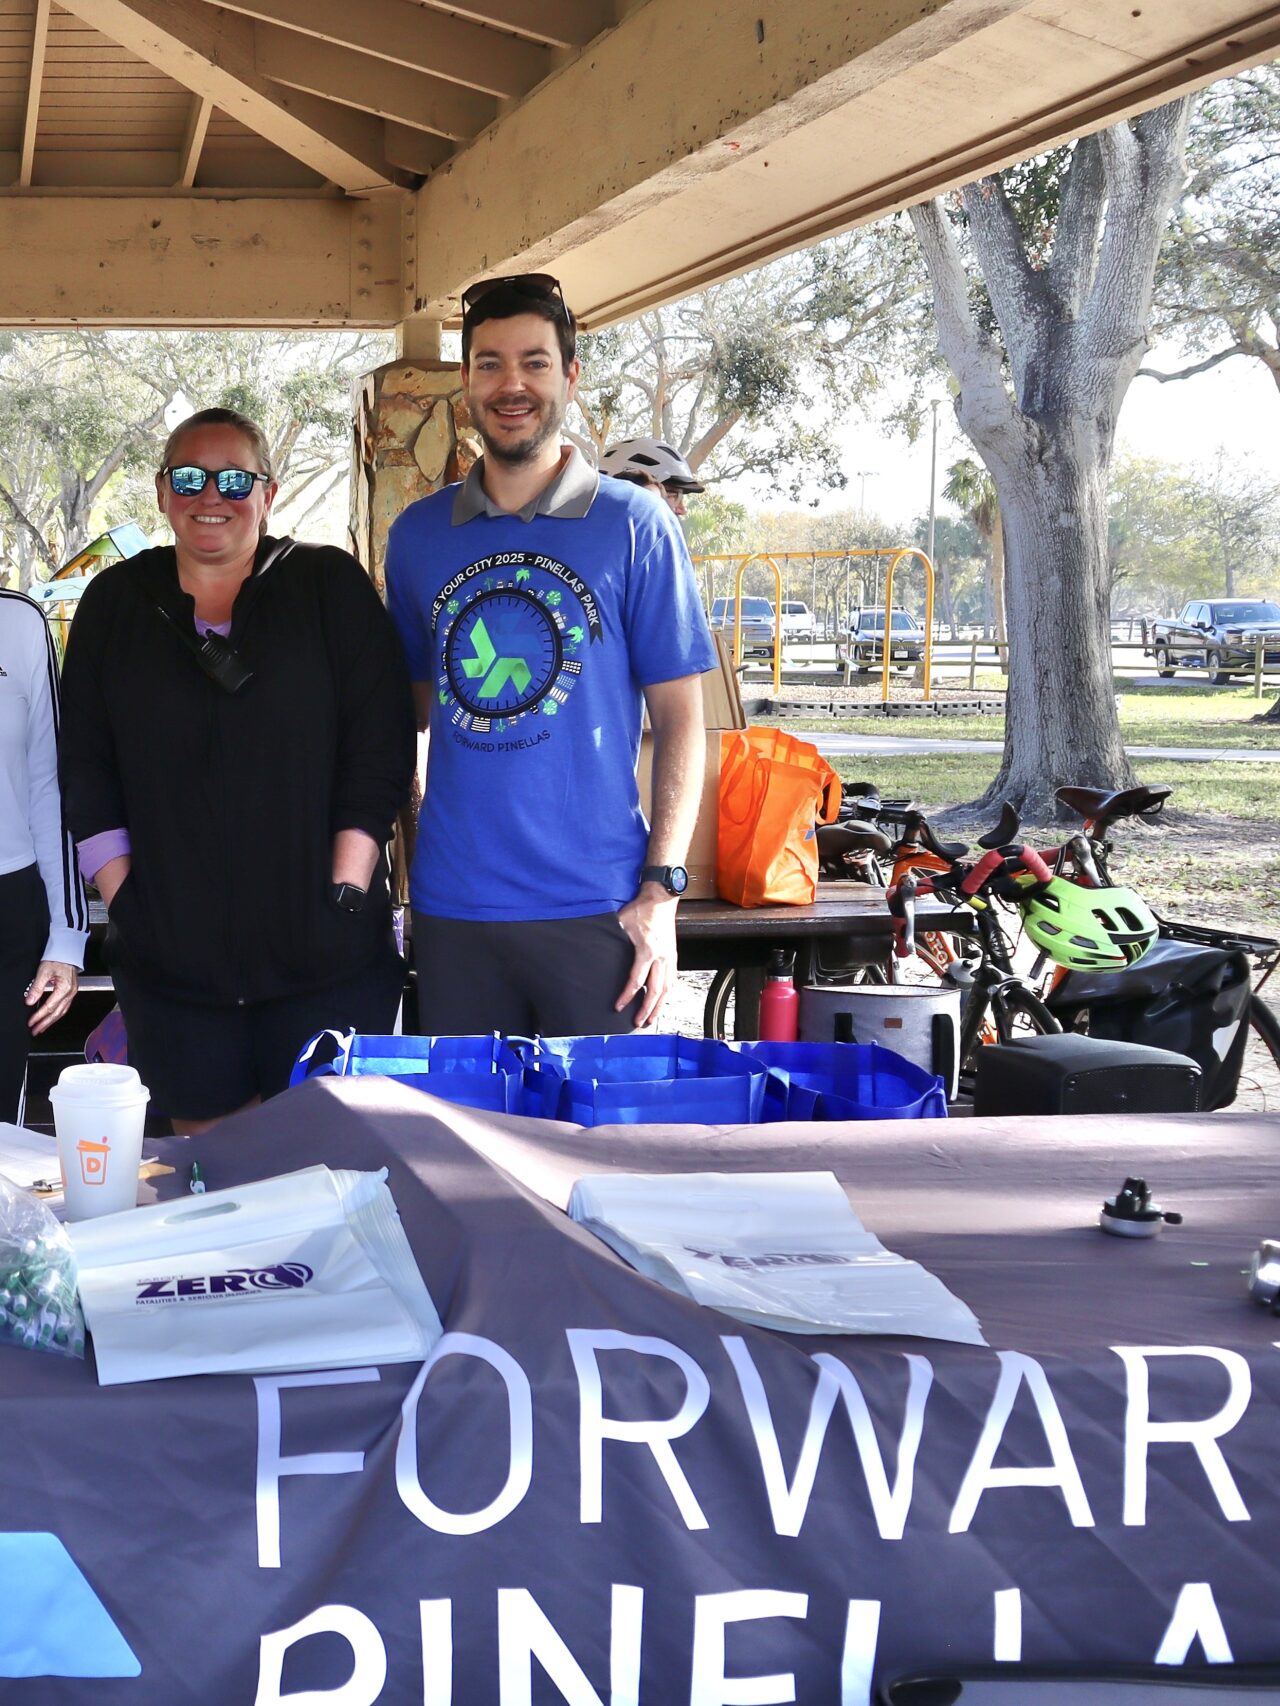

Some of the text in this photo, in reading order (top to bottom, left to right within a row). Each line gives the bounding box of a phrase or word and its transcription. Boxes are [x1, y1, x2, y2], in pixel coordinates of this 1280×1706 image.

[437, 573, 466, 600] YOUR
[465, 557, 493, 577] CITY
[495, 553, 525, 566] 2025
[534, 556, 585, 594] PINELLAS
[580, 596, 600, 627] PARK
[453, 730, 551, 752] FORWARD PINELLAS
[255, 1327, 1280, 1568] FORWAR
